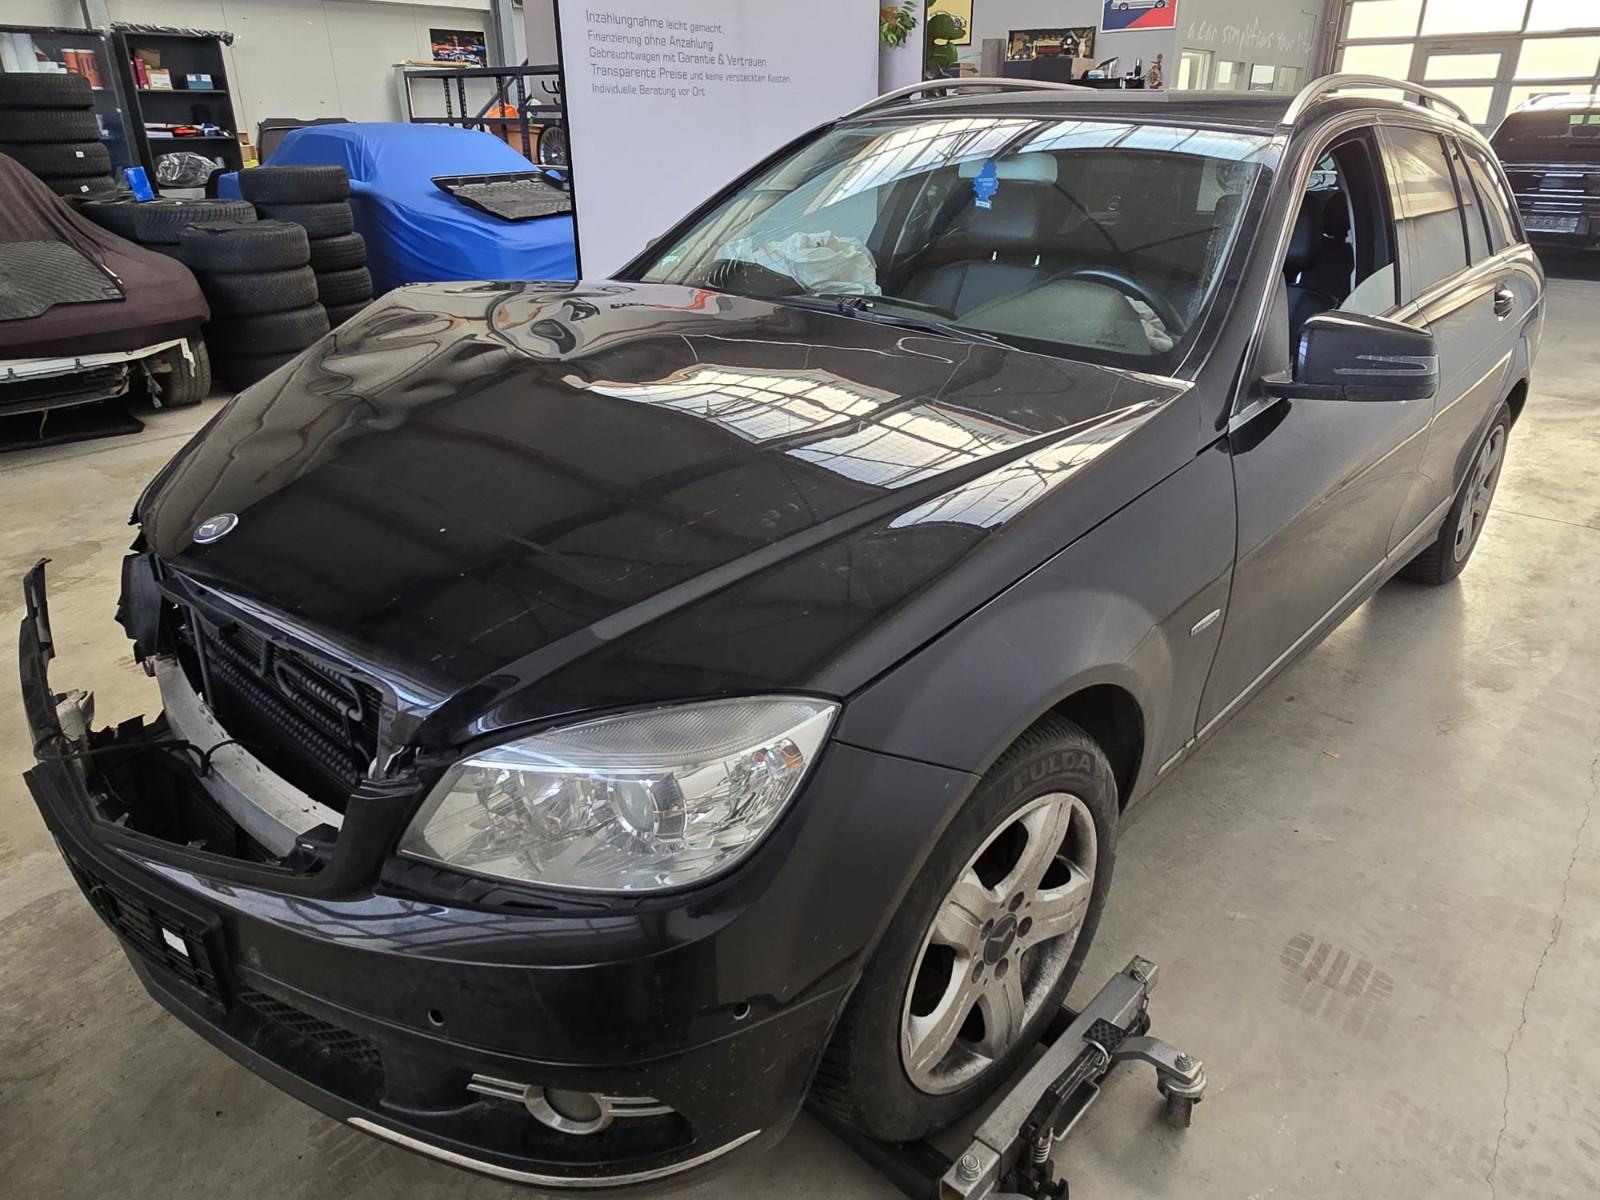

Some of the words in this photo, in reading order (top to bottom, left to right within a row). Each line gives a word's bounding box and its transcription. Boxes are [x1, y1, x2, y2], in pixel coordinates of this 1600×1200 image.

[586, 9, 664, 29] Inzahlungnahme
[665, 19, 688, 31] leicht
[587, 29, 642, 48] Finanzierung
[644, 33, 667, 47] ohne
[669, 35, 714, 52] Anzahlung
[588, 46, 660, 63] Gebrauchtwagen
[662, 53, 676, 63] mit
[678, 51, 716, 65] Garantie
[717, 53, 725, 66] &
[726, 54, 767, 67] Vertrauen
[590, 63, 656, 79] Transparente
[659, 67, 688, 80] Preise
[689, 71, 704, 81] und
[705, 72, 724, 82] keine
[725, 73, 766, 83] versteckten
[592, 83, 637, 95] Individuelle
[639, 84, 677, 98] Beratung
[679, 87, 691, 96] vor
[1012, 751, 1092, 792] FULDA
